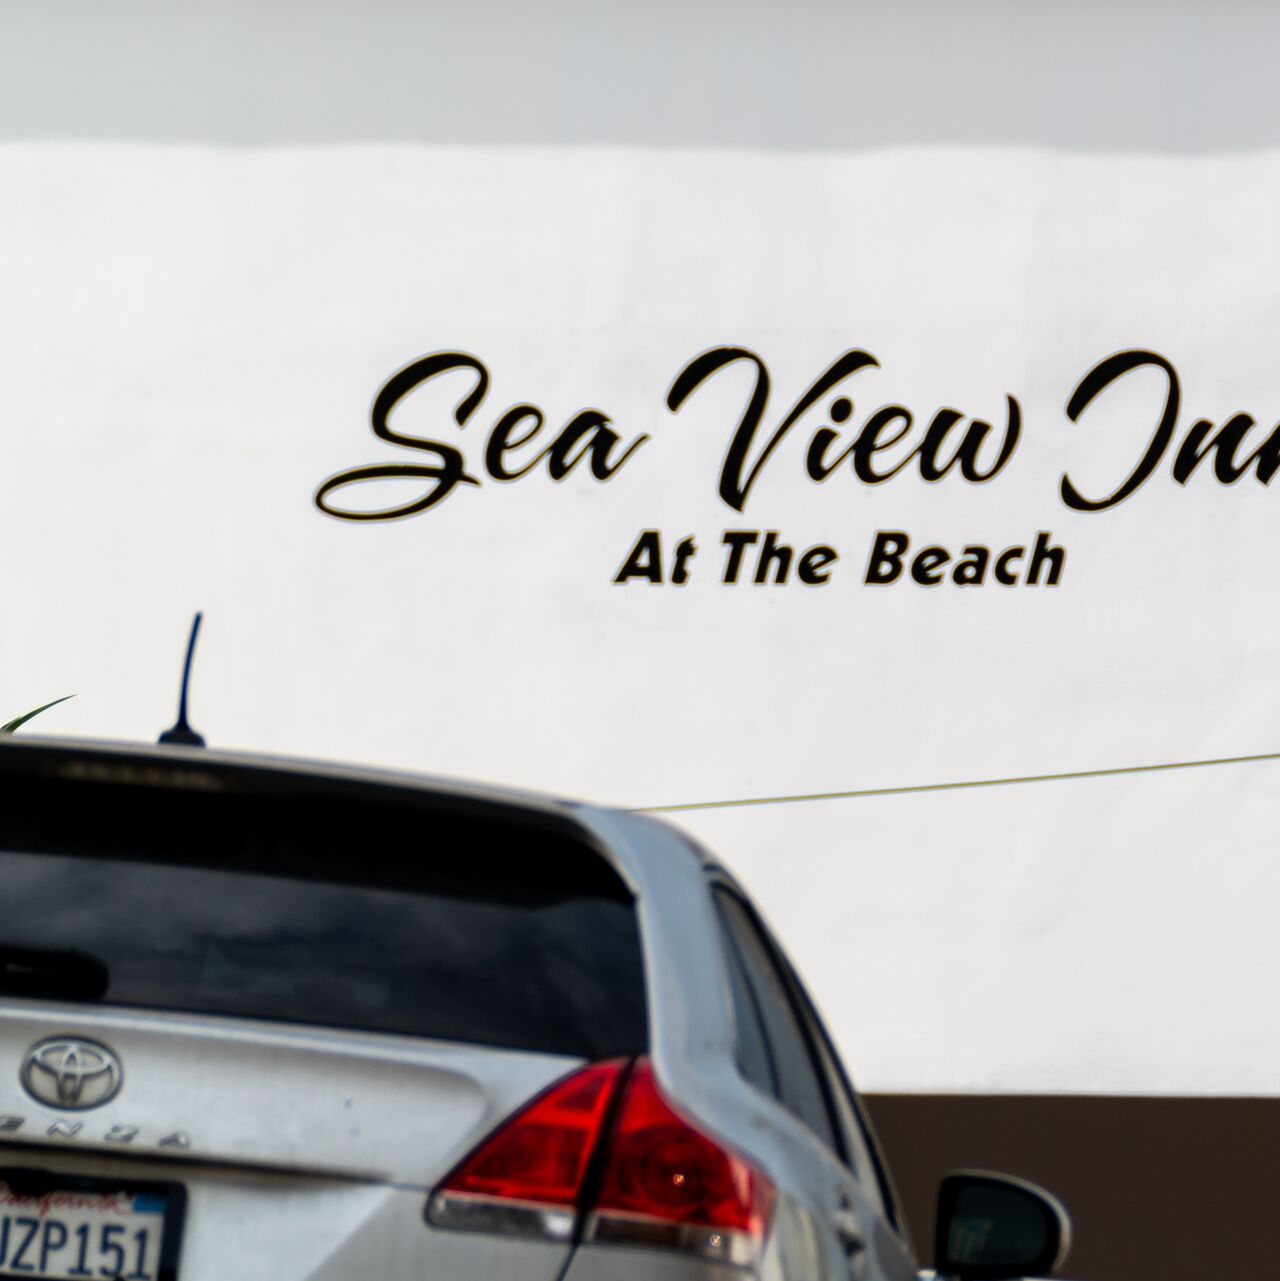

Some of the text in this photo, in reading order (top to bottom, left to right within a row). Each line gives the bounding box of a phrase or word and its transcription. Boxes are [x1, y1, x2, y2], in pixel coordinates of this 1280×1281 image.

[315, 352, 649, 521] Sea
[666, 346, 1022, 513] View
[614, 531, 1066, 587] At The Beach
